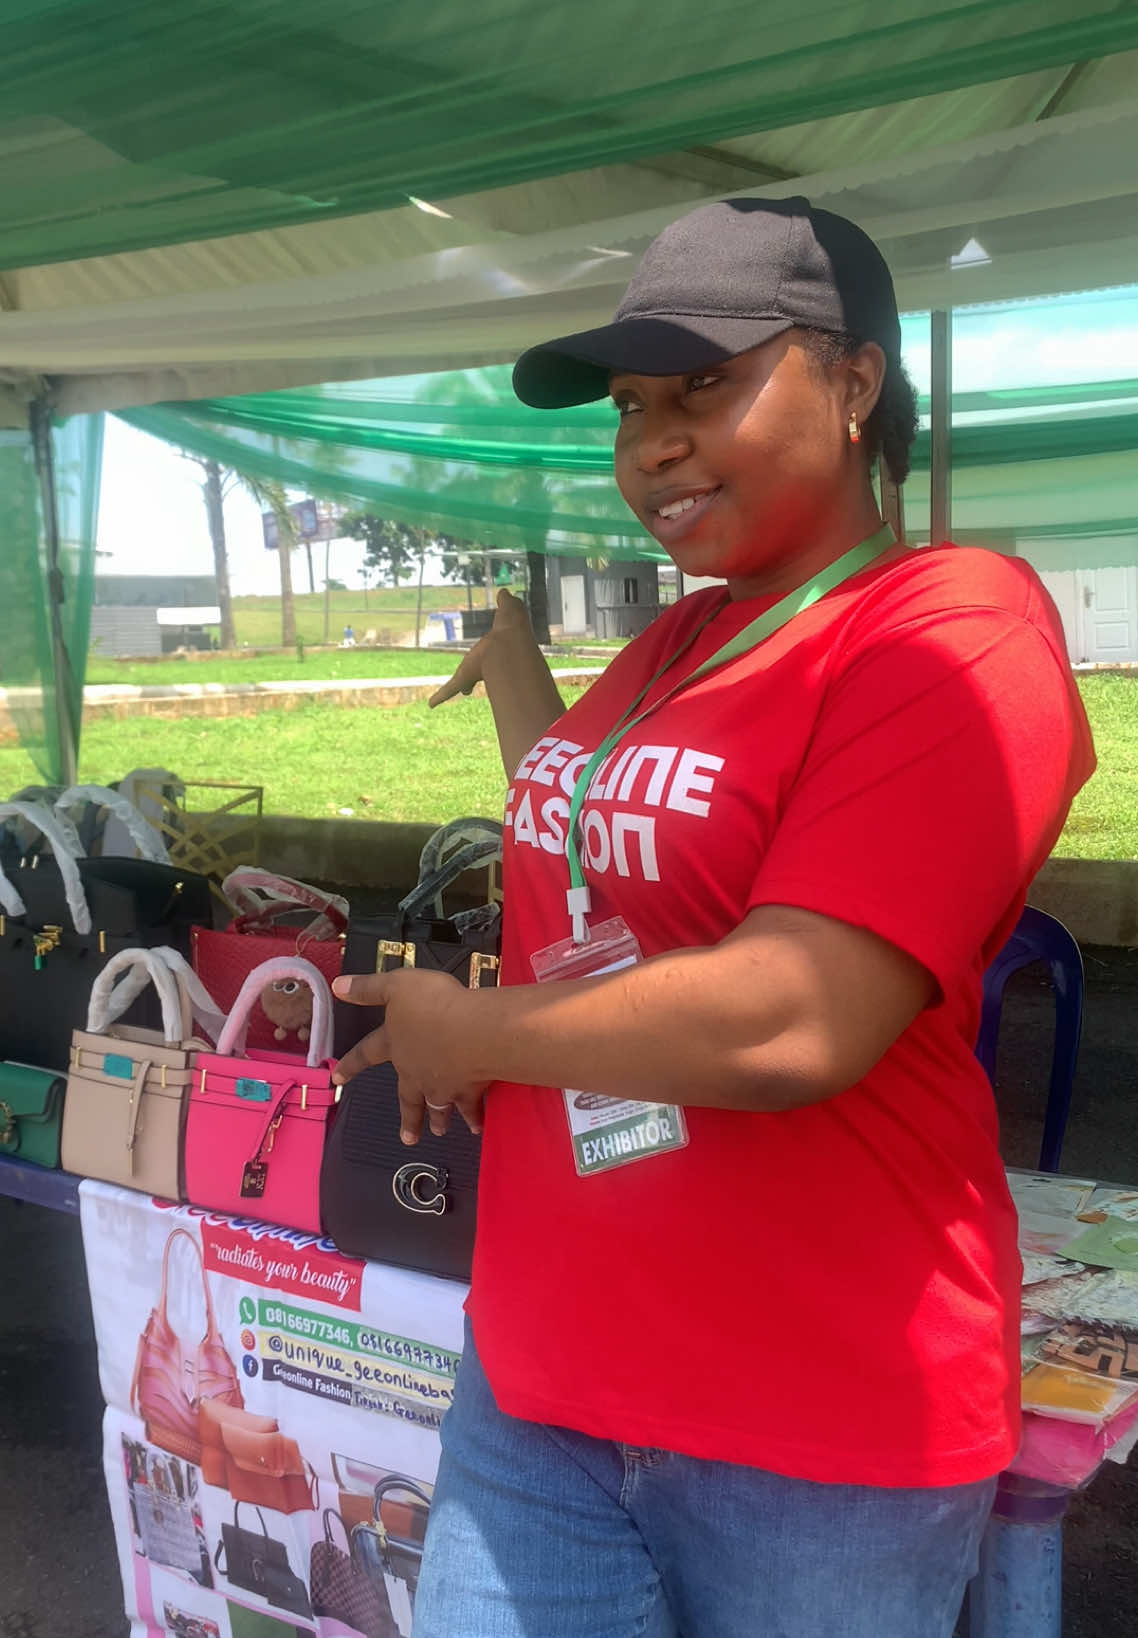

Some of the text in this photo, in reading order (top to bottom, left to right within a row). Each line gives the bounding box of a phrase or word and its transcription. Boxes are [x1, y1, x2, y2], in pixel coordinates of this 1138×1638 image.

[581, 1117, 673, 1166] EXHIBITOR
[266, 1260, 299, 1282] your
[314, 1378, 352, 1399] Fashion
